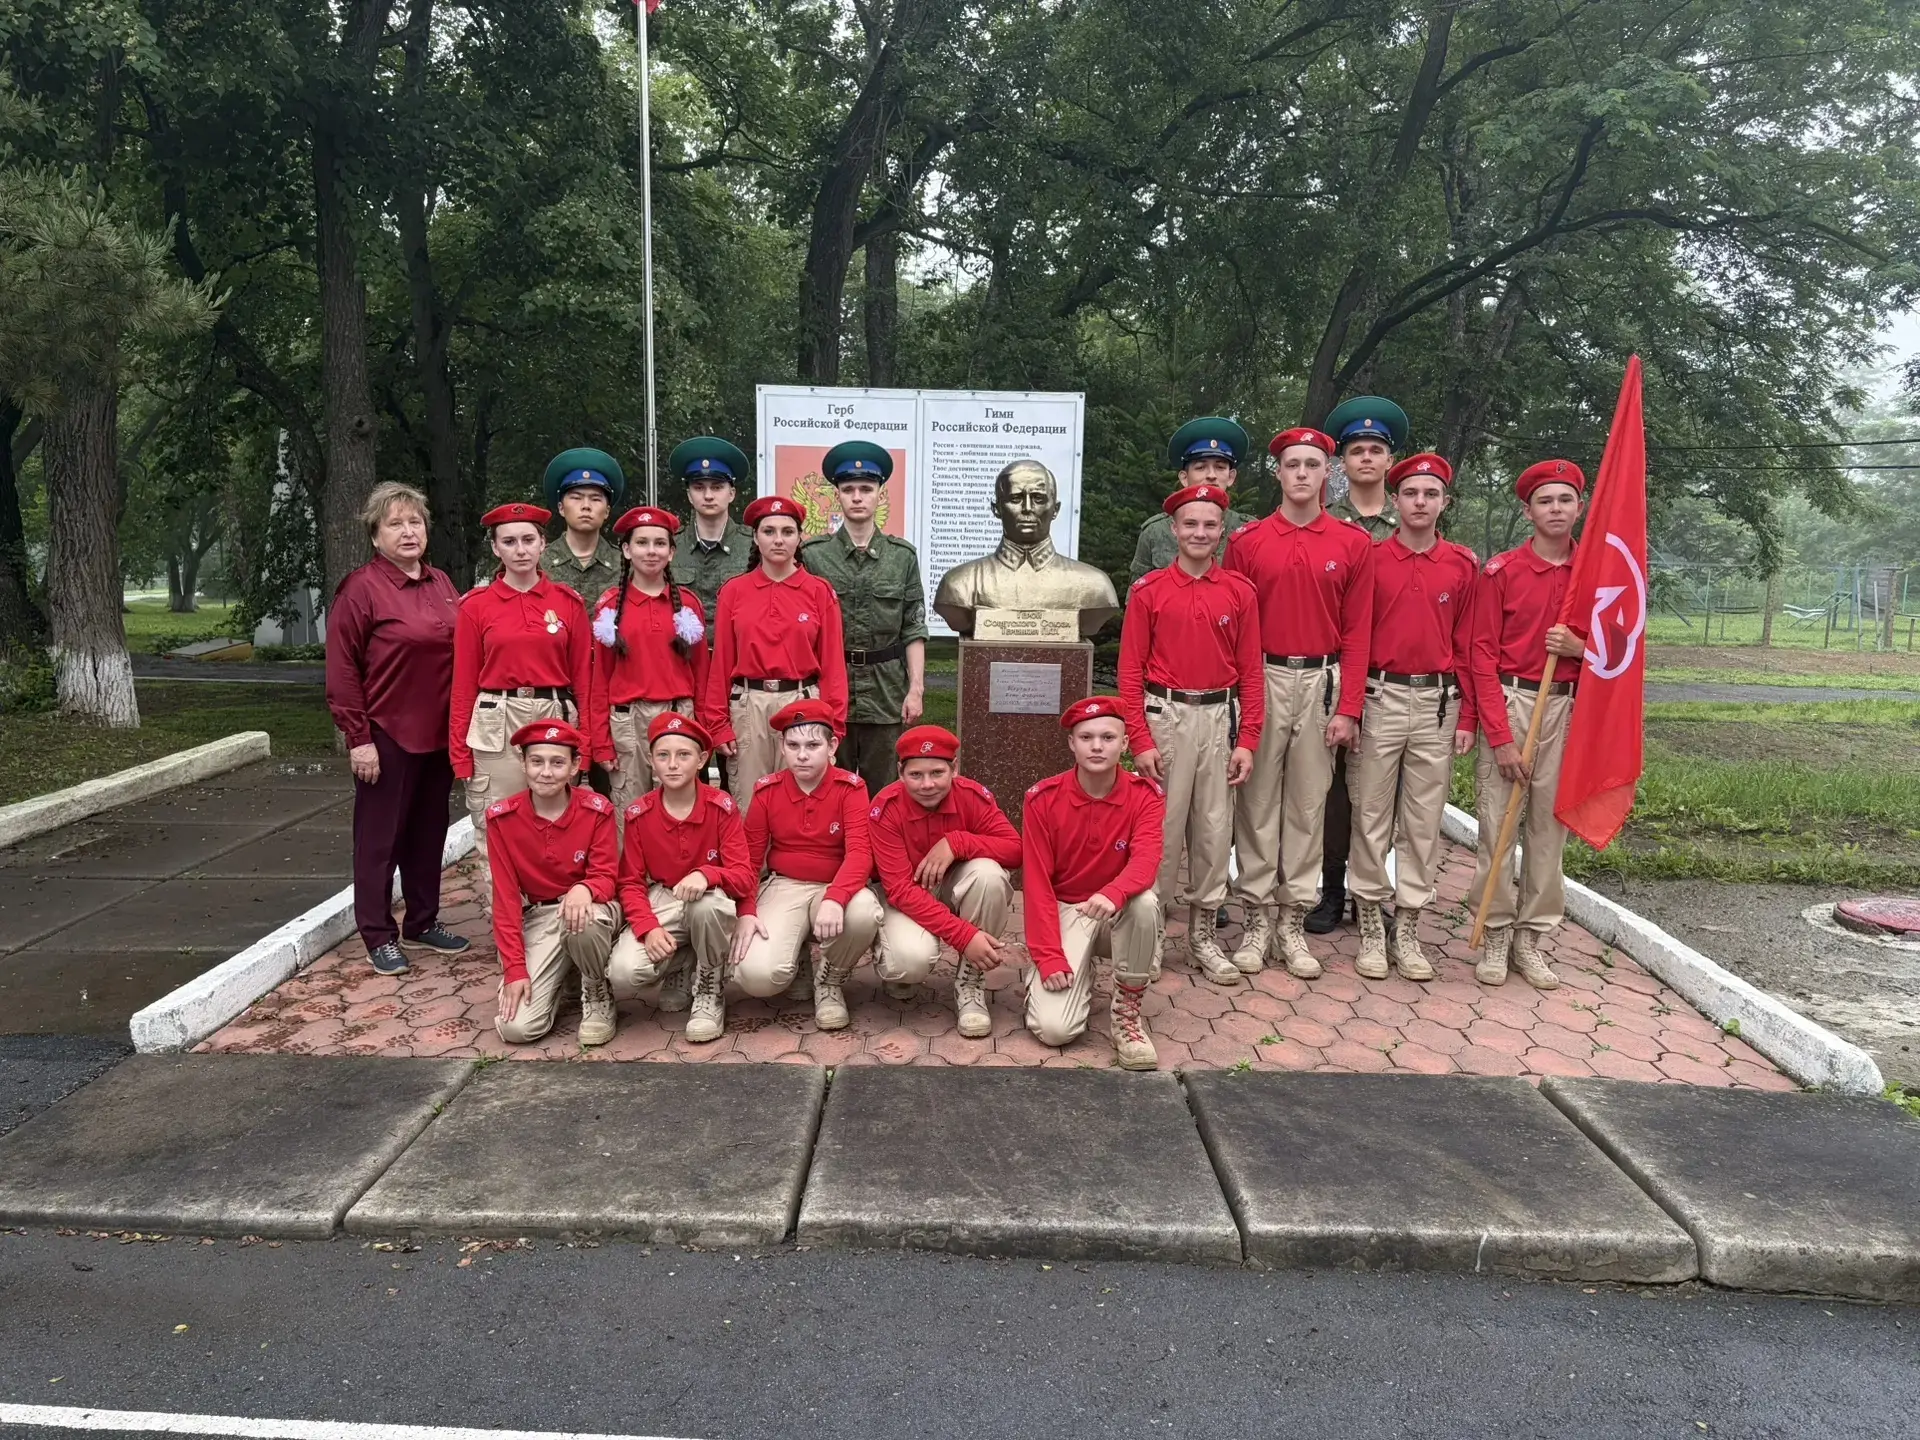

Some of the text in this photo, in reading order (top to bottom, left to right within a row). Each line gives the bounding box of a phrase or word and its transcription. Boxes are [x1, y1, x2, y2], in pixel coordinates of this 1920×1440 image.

[827, 404, 855, 417] Герб
[985, 408, 1014, 419] Гимн
[773, 417, 908, 432] Российской Федерации
[932, 421, 1067, 436] Российской Федерации
